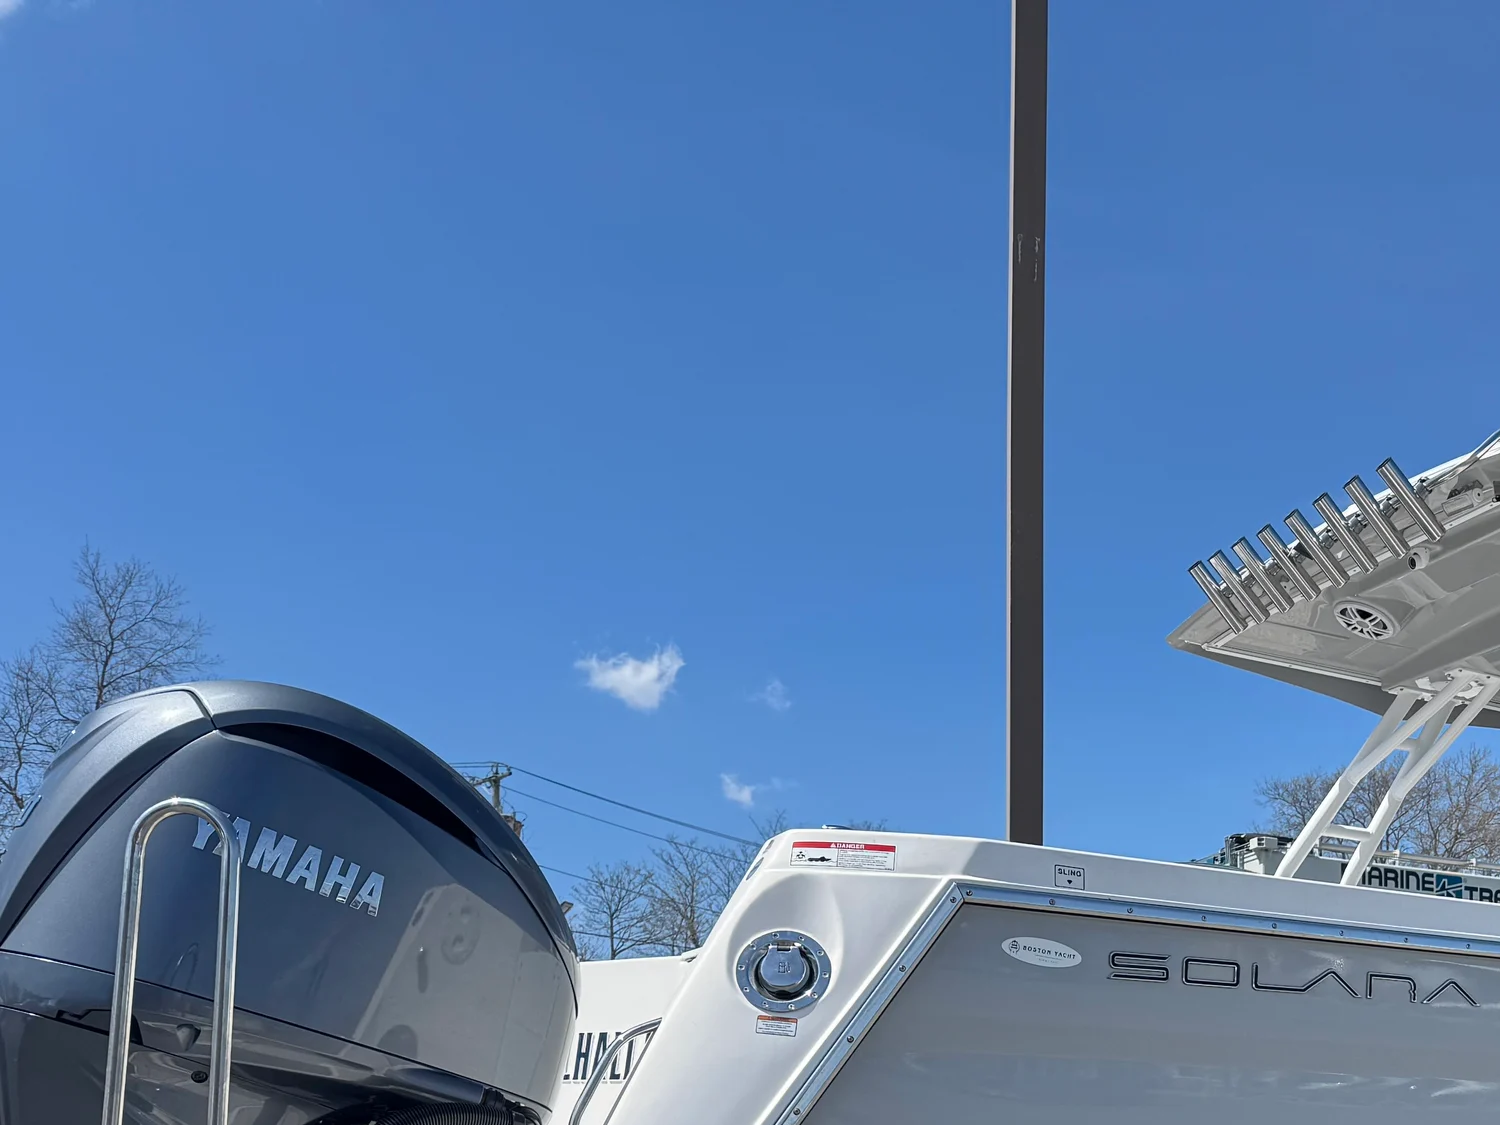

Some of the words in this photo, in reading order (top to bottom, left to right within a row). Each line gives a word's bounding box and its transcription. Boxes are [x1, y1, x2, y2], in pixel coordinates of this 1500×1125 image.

[192, 812, 385, 917] YAMAHA
[1057, 868, 1082, 877] SLING
[1022, 945, 1052, 955] BOSTON
[1054, 951, 1076, 959] YACHT
[1107, 951, 1480, 1007] SOLARA
